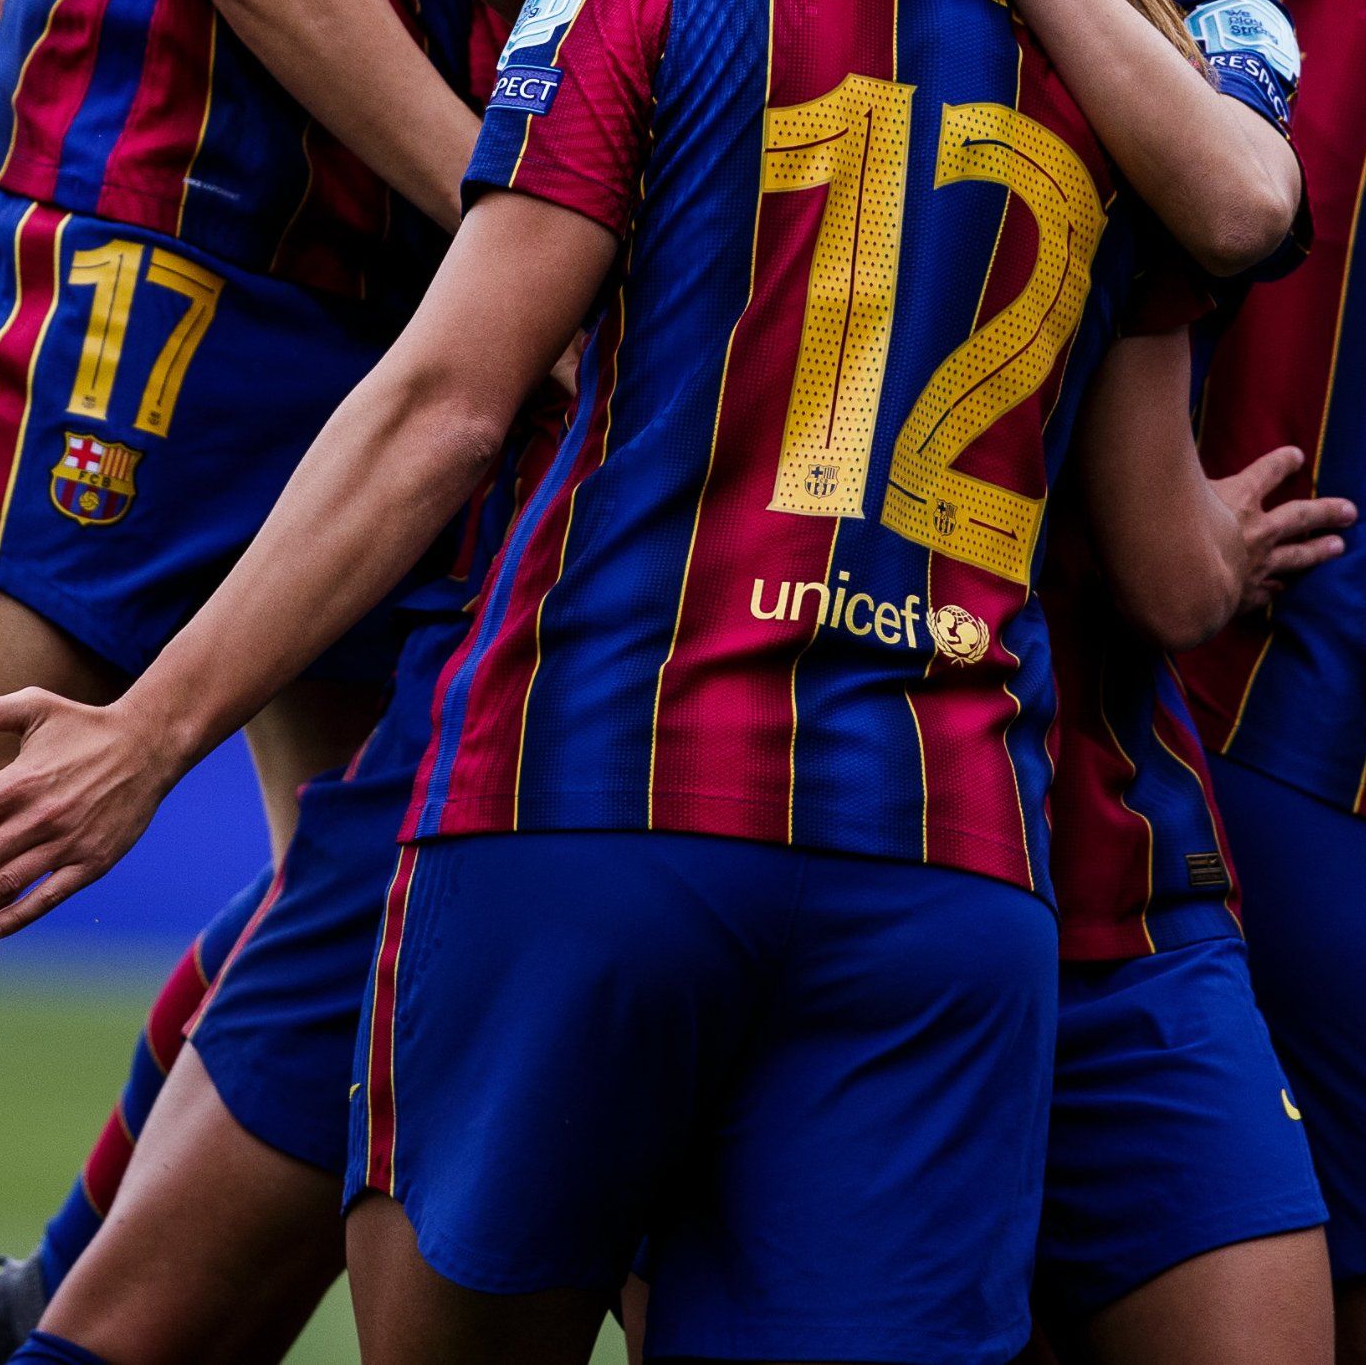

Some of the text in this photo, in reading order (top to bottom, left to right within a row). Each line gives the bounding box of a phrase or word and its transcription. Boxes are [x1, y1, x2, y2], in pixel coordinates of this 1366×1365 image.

[66, 238, 226, 438] 17
[761, 73, 1109, 584] 12
[79, 470, 112, 488] FCB
[750, 570, 921, 649] unicef
